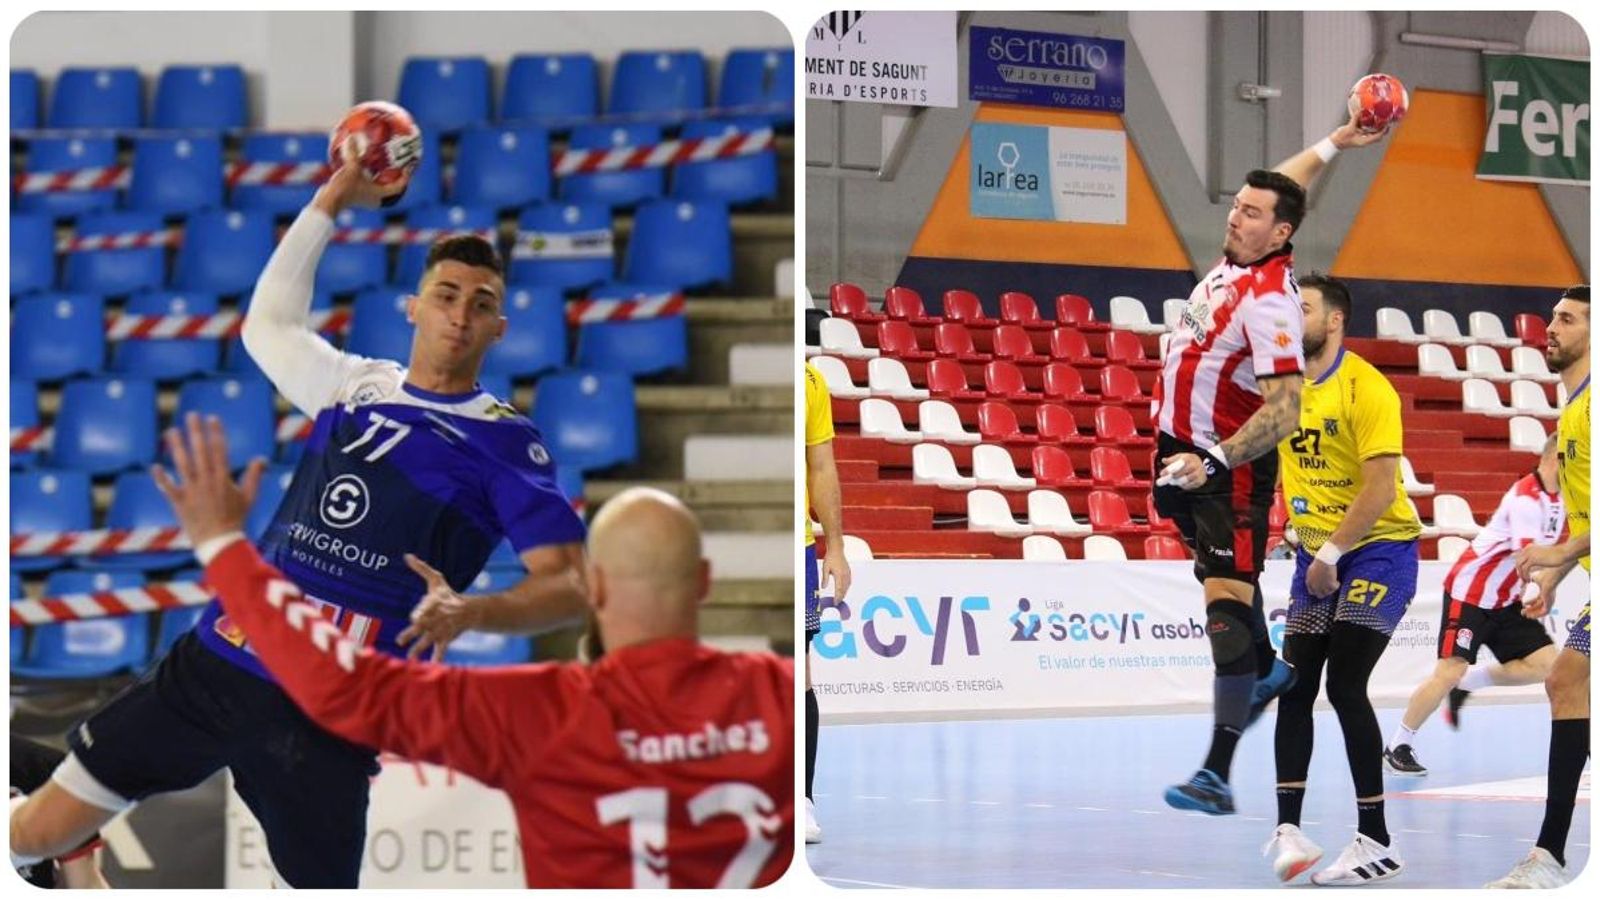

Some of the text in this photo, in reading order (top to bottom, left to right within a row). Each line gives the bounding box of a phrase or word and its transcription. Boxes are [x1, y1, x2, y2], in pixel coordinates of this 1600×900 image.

[850, 60, 867, 77] DE
[872, 61, 928, 81] SAGUNT
[843, 84, 928, 102] D'ESPORTS
[1485, 80, 1590, 157] Fer
[341, 411, 411, 462] 77
[1290, 427, 1321, 456] 27
[1346, 578, 1388, 608] 27
[1047, 612, 1145, 644] sacyr
[1039, 654, 1211, 670] El valor de nuestras manos
[893, 680, 950, 693] SERVICIOS
[617, 720, 769, 763] Sanchez
[422, 829, 471, 873] DE
